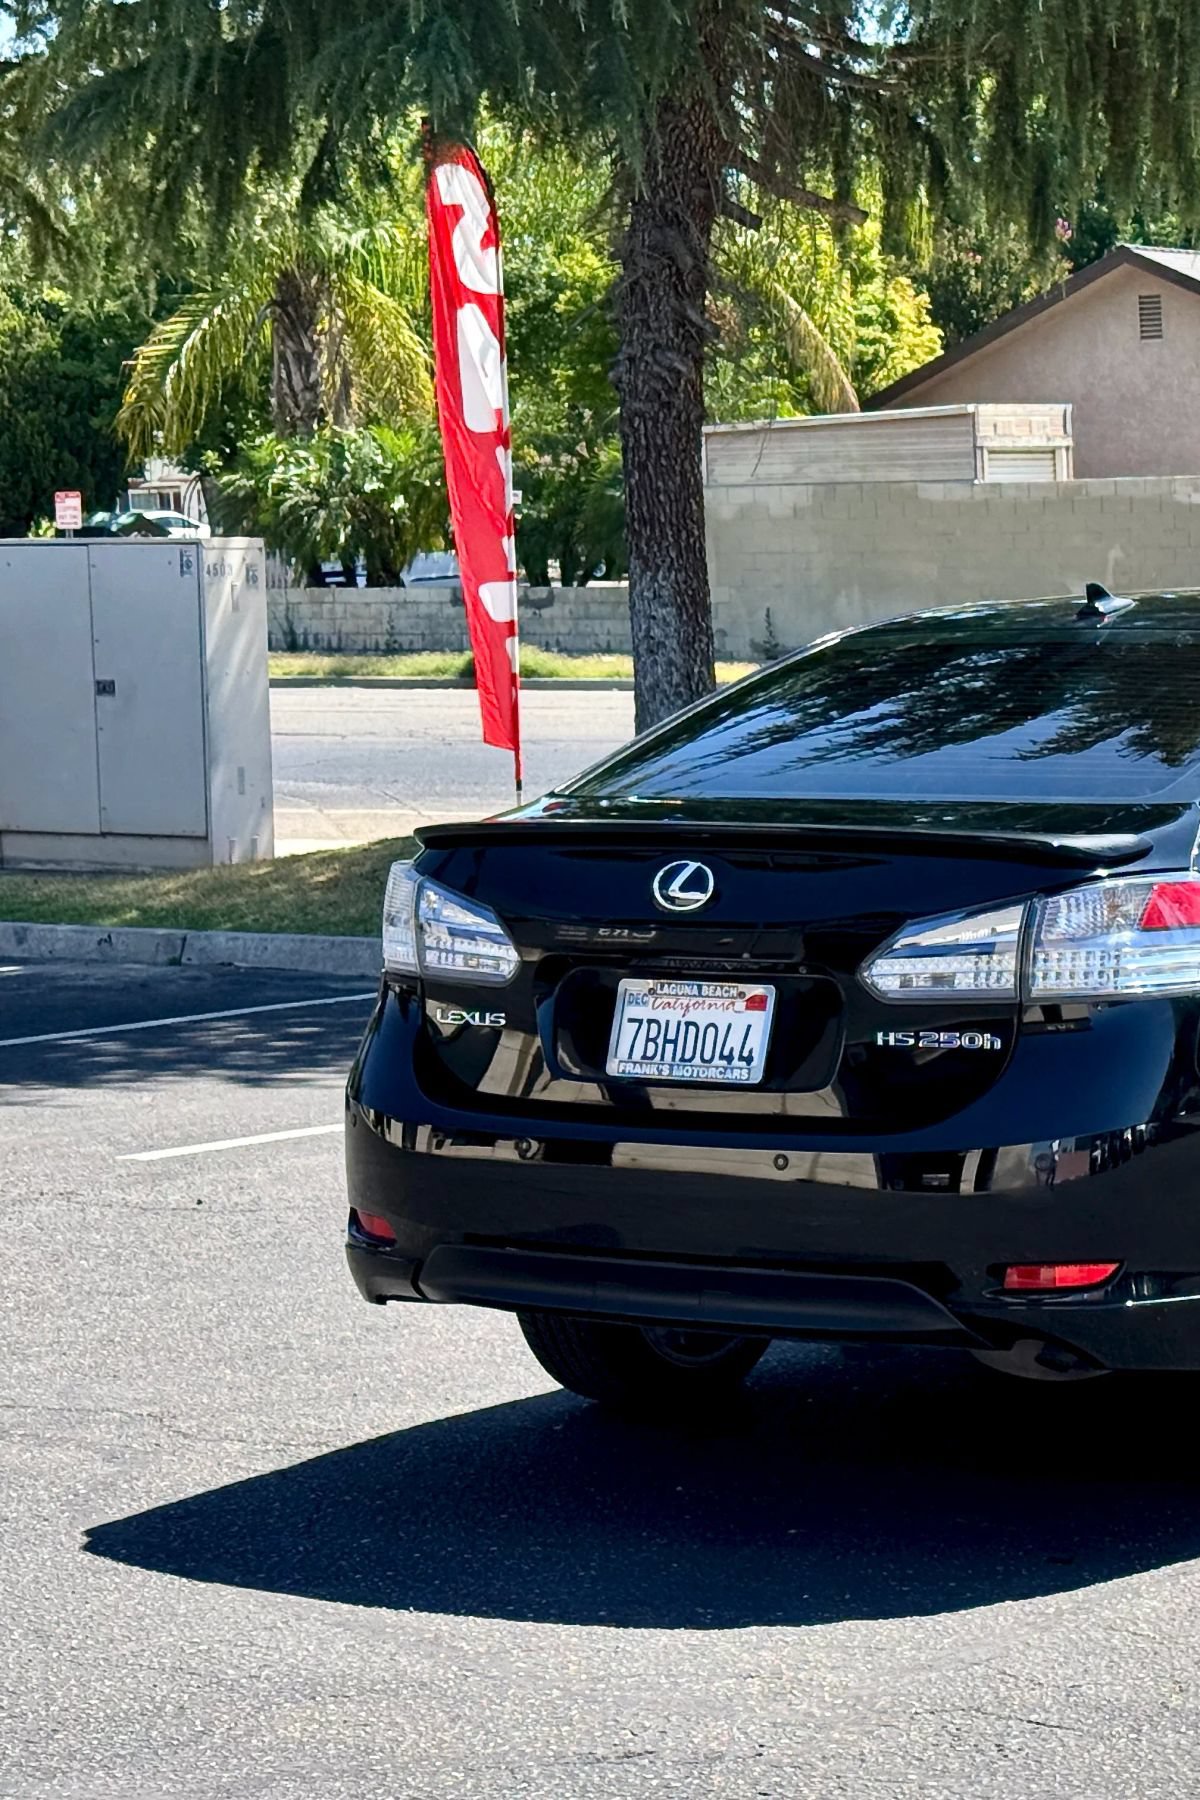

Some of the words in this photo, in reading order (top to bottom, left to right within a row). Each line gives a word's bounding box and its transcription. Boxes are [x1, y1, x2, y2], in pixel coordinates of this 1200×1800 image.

[628, 992, 648, 1006] DEC
[656, 983, 698, 996] LAGUNA
[701, 986, 738, 998] BEACH
[651, 997, 743, 1017] California
[436, 1008, 506, 1027] LEXUS
[626, 1017, 754, 1066] 7BHD044
[618, 1062, 670, 1076] FRANK'S
[672, 1065, 749, 1080] MOTORCARS
